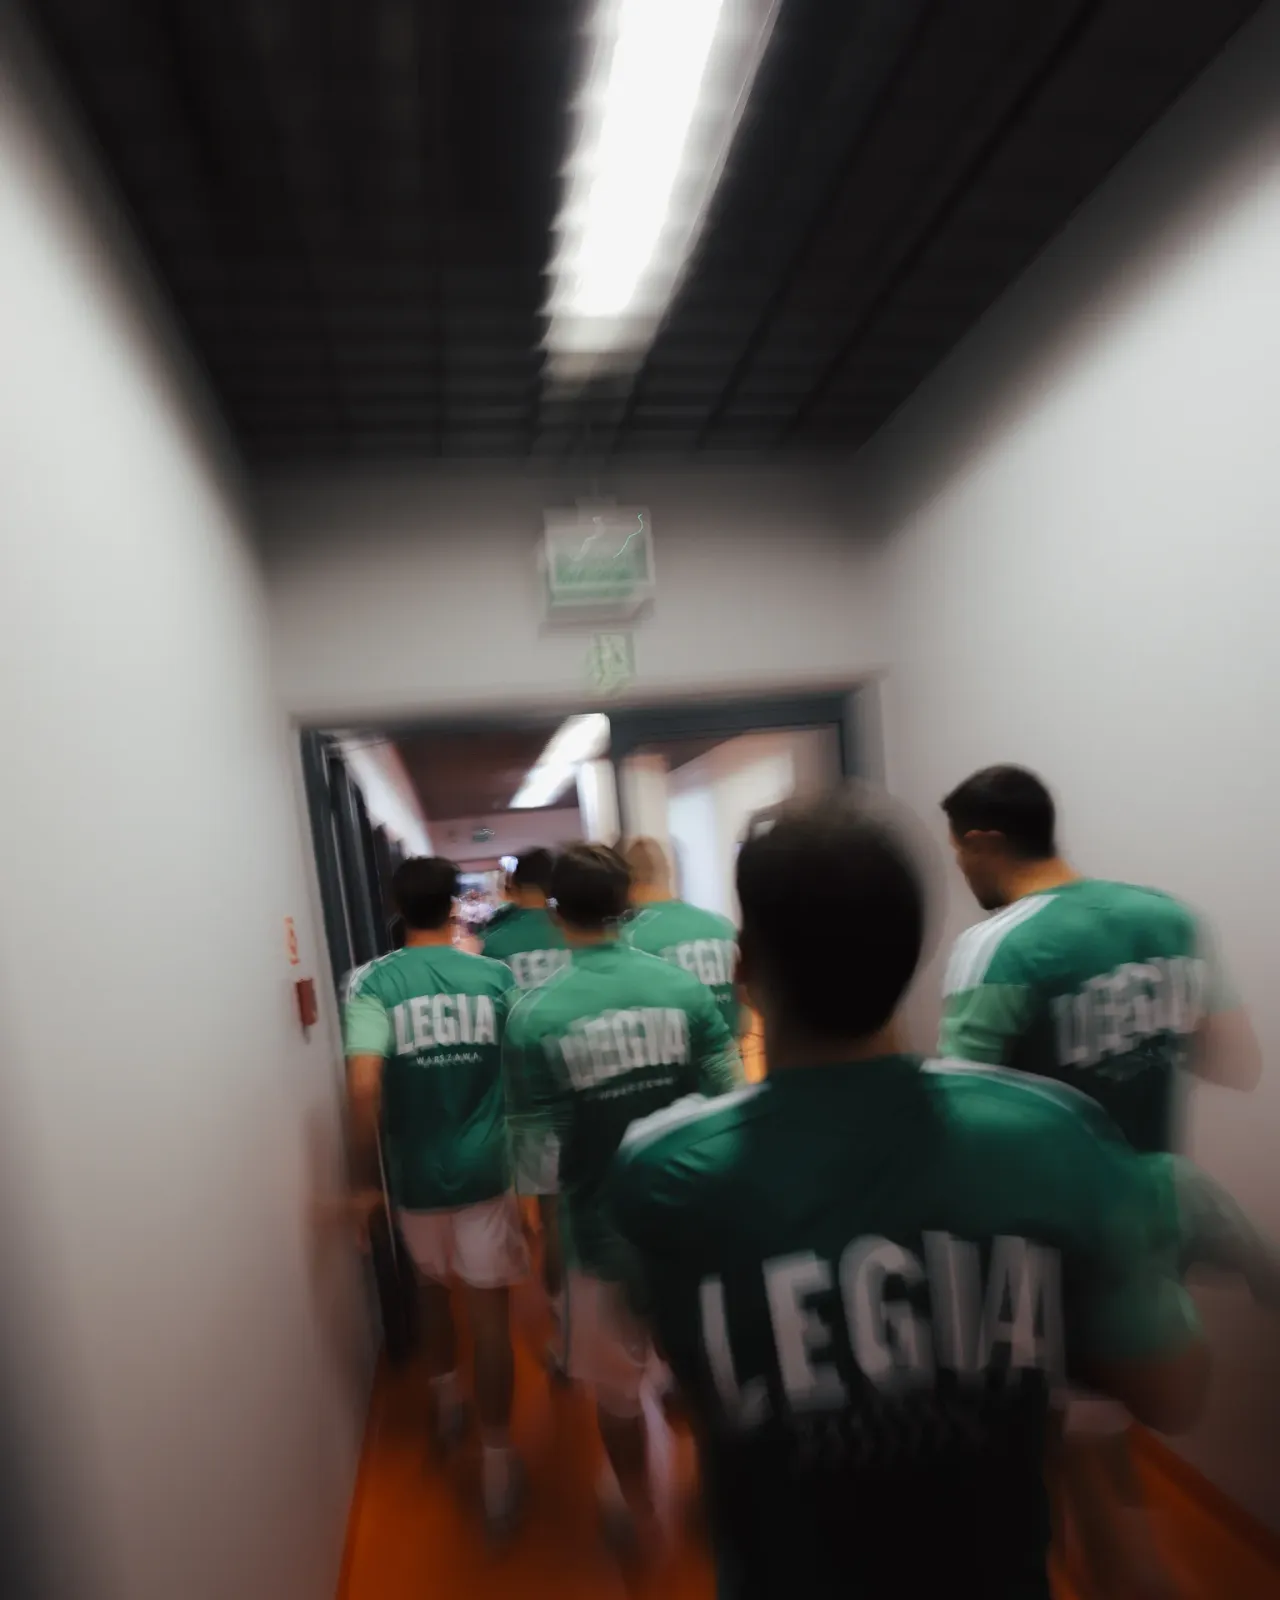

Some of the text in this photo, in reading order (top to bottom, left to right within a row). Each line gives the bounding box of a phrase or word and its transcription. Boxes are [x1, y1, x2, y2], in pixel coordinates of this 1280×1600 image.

[675, 938, 740, 987] EGI
[393, 993, 497, 1056] LEGIA
[548, 1006, 689, 1091] LEGIA
[415, 1051, 481, 1067] WARSZAWA
[699, 1230, 1066, 1430] LEGIA
